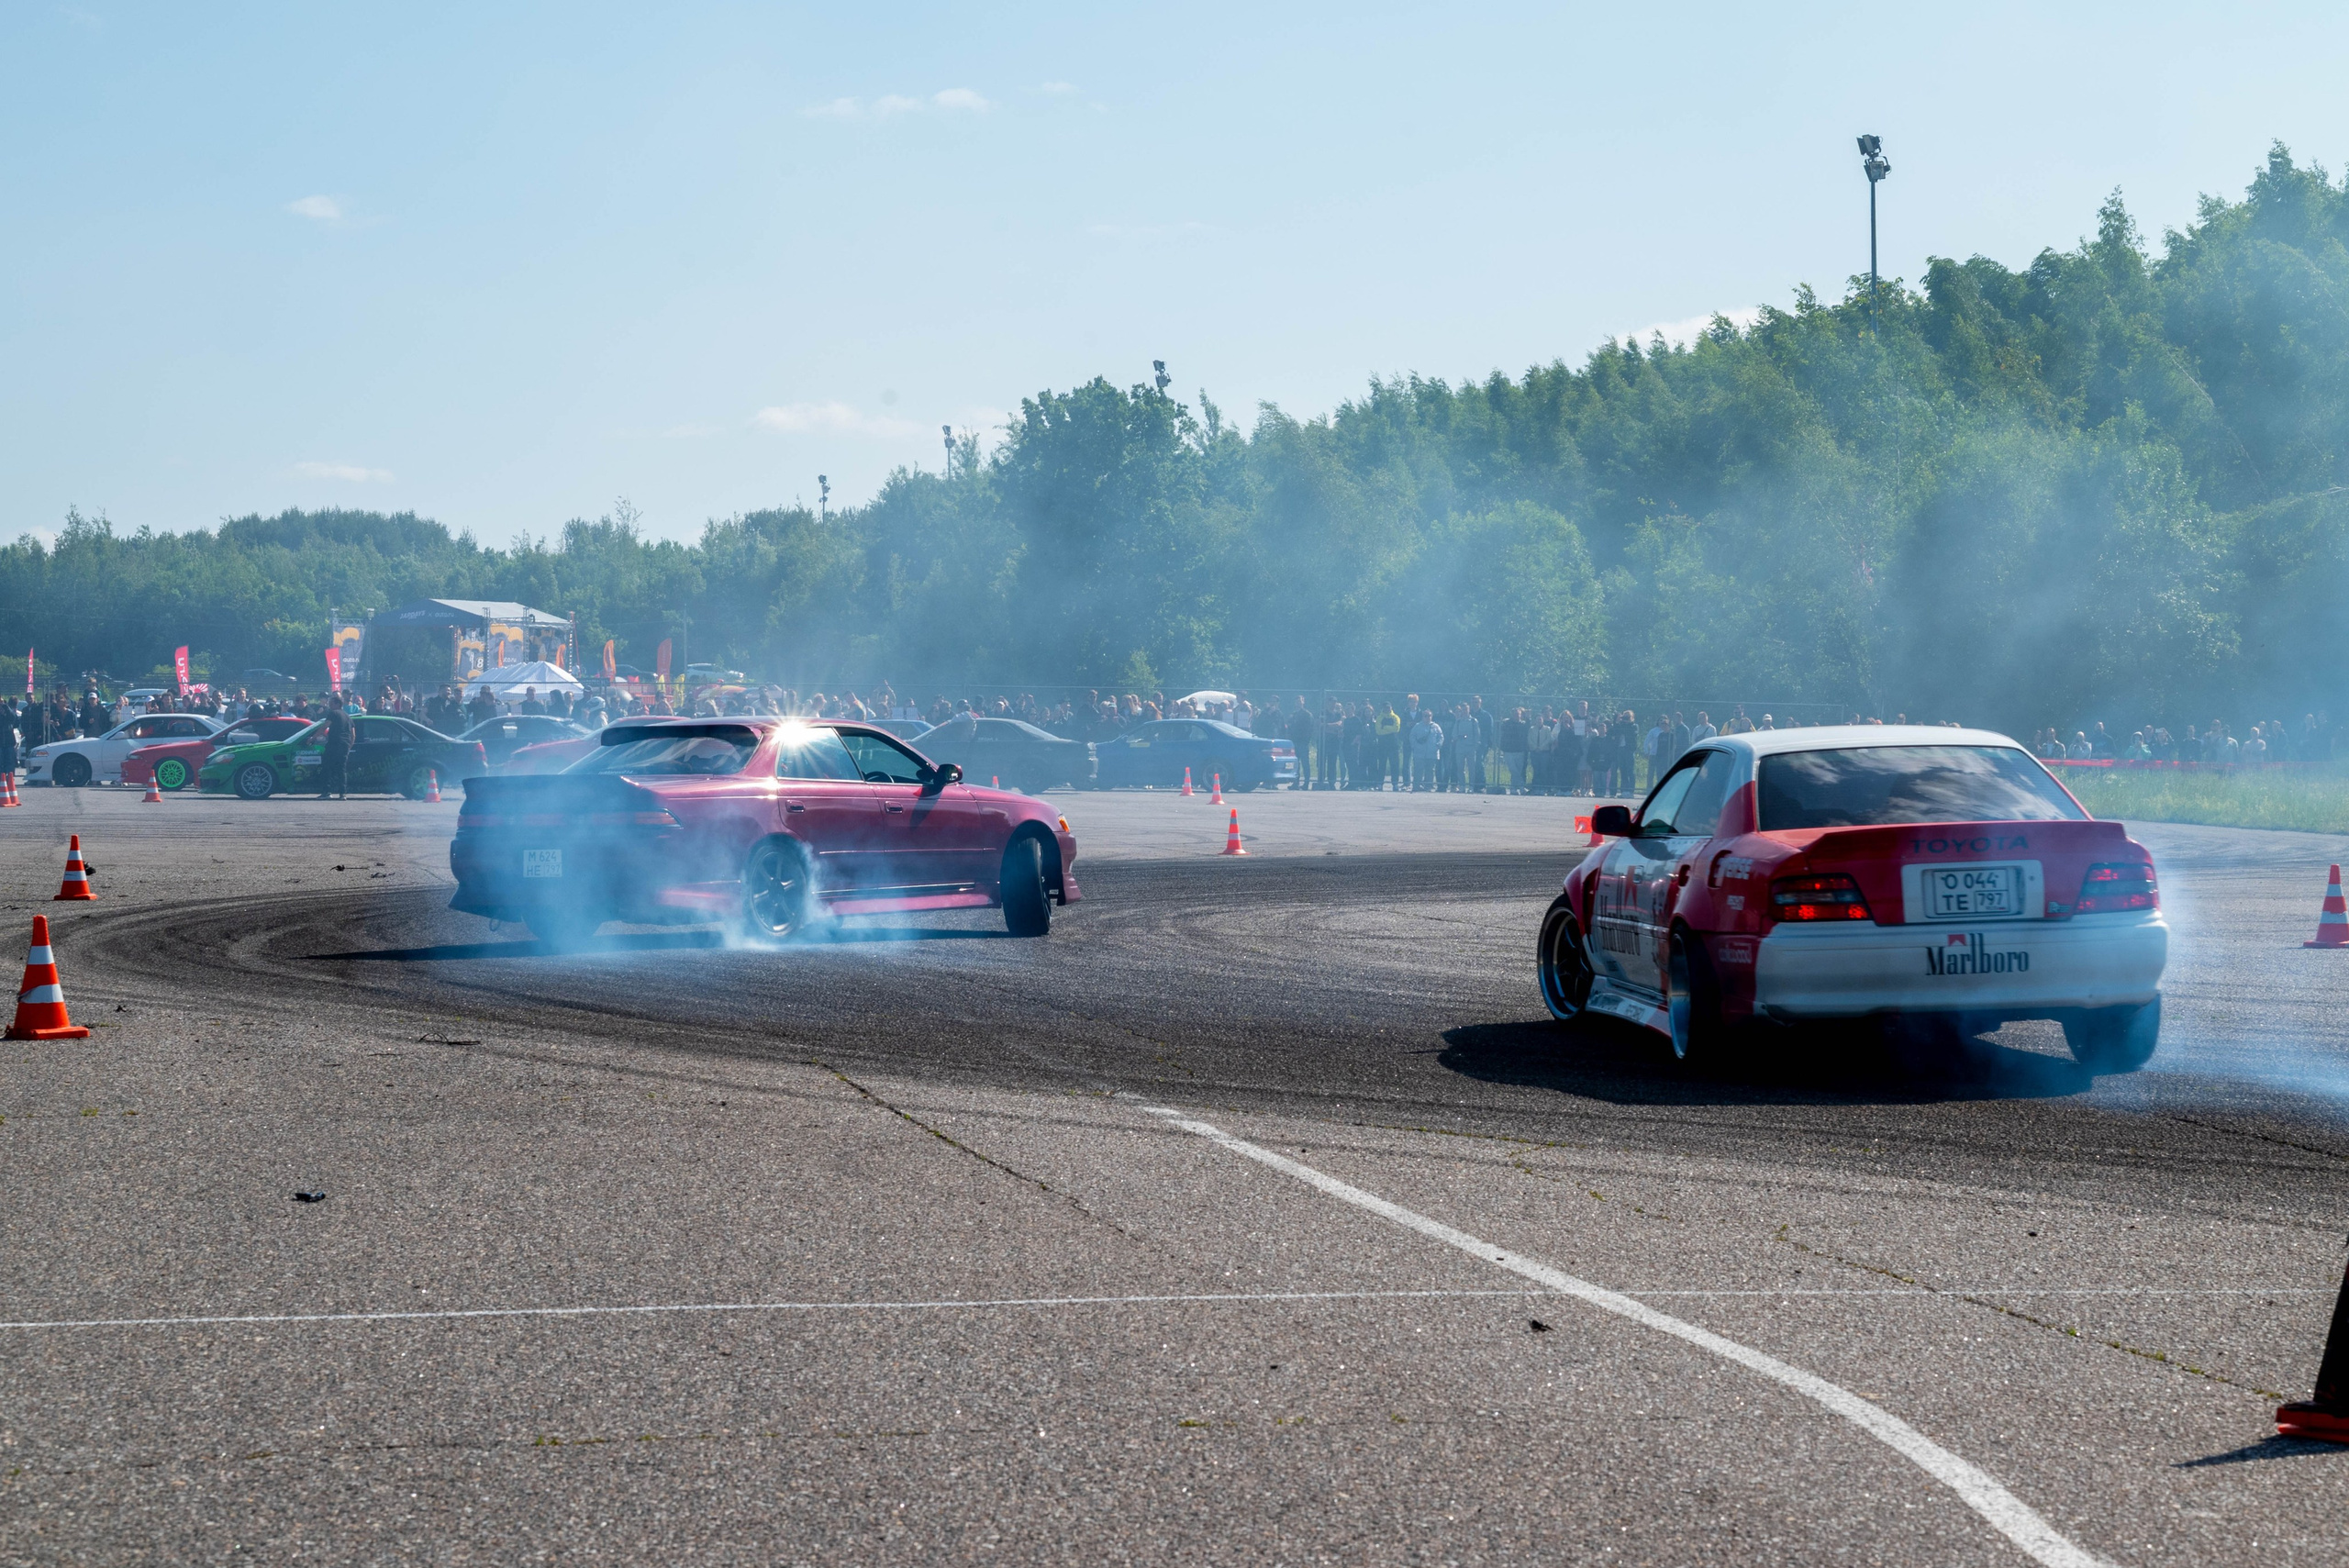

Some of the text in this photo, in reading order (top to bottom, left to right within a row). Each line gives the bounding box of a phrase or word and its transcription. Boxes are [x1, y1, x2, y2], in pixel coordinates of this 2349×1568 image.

[1910, 836, 2029, 853] TOYOTA
[528, 851, 556, 862] M 624
[527, 865, 541, 876] HE
[1964, 873, 1997, 889] 044
[1942, 893, 2004, 910] TE 797
[1925, 932, 2030, 976] Marlboro
